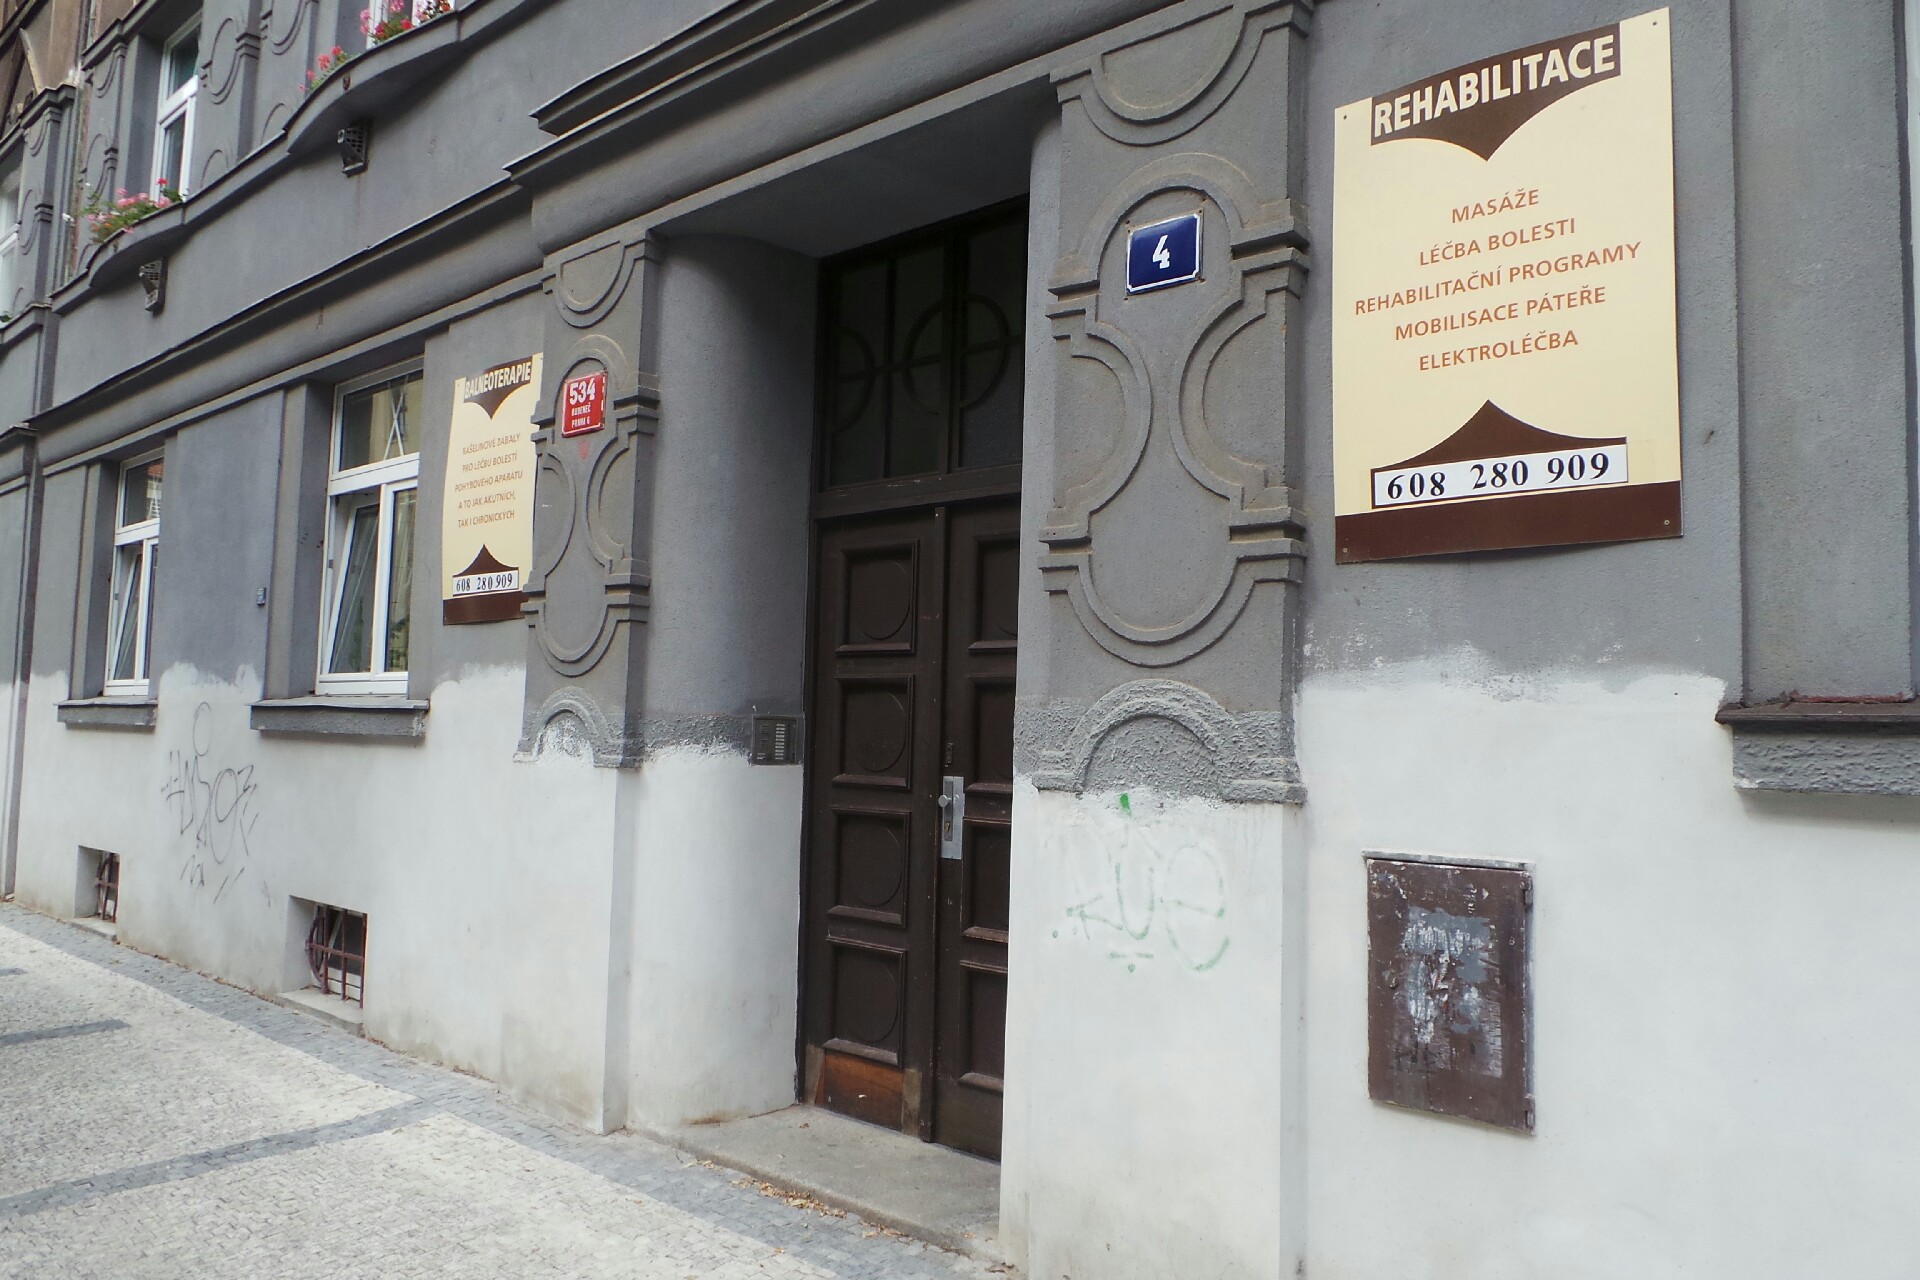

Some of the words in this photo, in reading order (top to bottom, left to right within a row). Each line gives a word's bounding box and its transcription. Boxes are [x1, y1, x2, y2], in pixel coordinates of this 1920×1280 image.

[1374, 34, 1616, 138] REHABILITACE
[1451, 188, 1540, 224] MASÁŽE
[1152, 234, 1171, 270] 4
[1419, 240, 1482, 266] LÉČBA
[1487, 217, 1576, 251] BOLESTI
[1354, 264, 1502, 316] REHABILITAČNÍ
[1508, 241, 1642, 284] PROGRAMY
[1394, 301, 1520, 341] MOBILISACE
[1526, 284, 1607, 317] PÁTEŘE
[1418, 329, 1580, 372] ELEKTROLÉČBA
[464, 361, 532, 399] BALNEOTERAPIE
[569, 377, 596, 405] 534
[462, 461, 474, 472] PRO
[1386, 470, 1447, 500] 608
[1469, 459, 1530, 491] 280
[1545, 452, 1610, 485] 909
[463, 499, 472, 509] TO
[457, 518, 469, 528] TAK
[456, 578, 471, 592] 608
[476, 576, 494, 591] 280
[495, 573, 513, 588] 909
